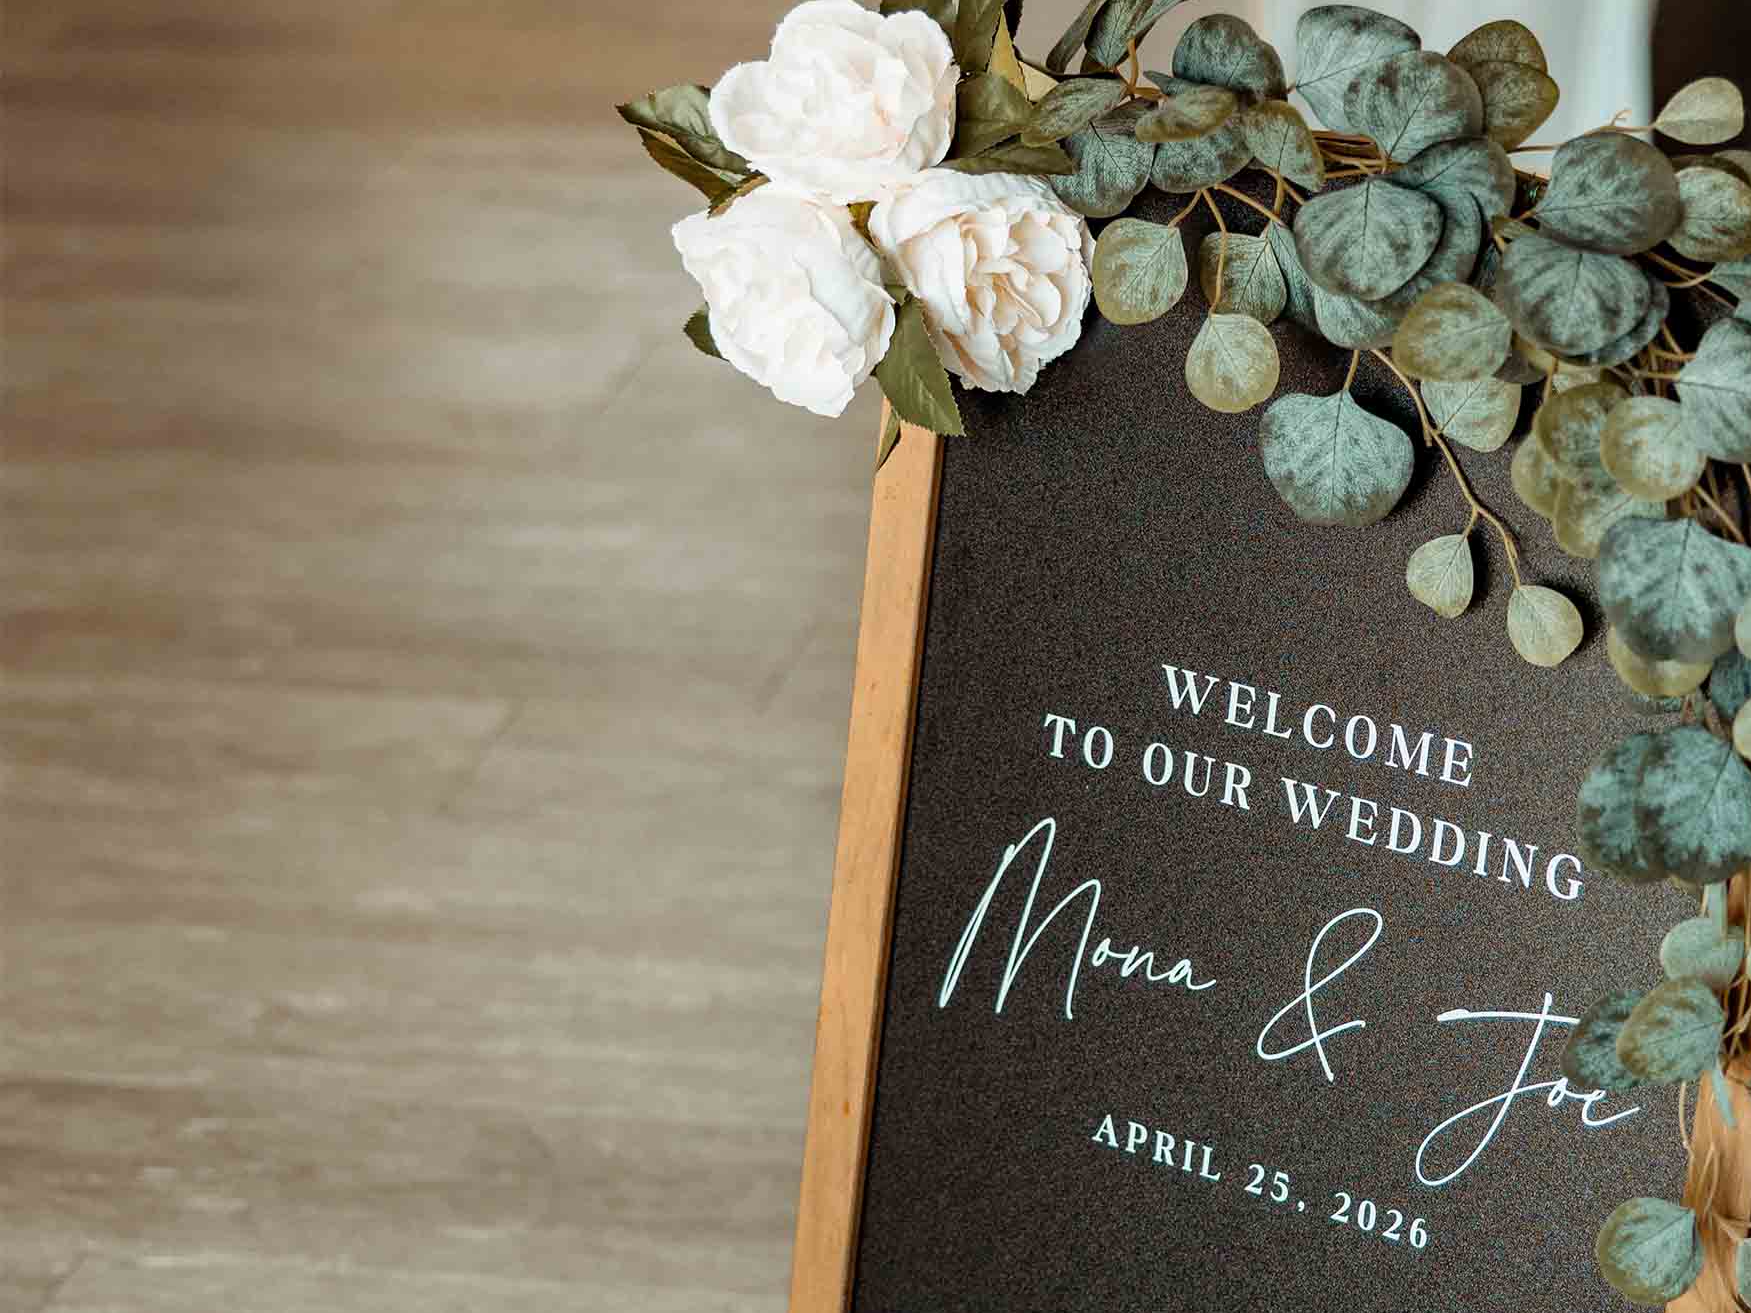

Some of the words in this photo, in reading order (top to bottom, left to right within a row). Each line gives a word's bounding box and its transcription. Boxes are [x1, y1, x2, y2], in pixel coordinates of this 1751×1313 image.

[1162, 663, 1474, 788] WELCOME
[1043, 713, 1114, 773] TO
[1142, 741, 1253, 812] OUR
[1282, 776, 1585, 901] WEDDING
[938, 817, 1217, 1021] Mona
[1256, 907, 1384, 1082] &
[1415, 992, 1643, 1187] Joe
[1091, 1113, 1221, 1182] APRIL
[1243, 1163, 1307, 1212] 25,
[1330, 1192, 1429, 1250] 2026
